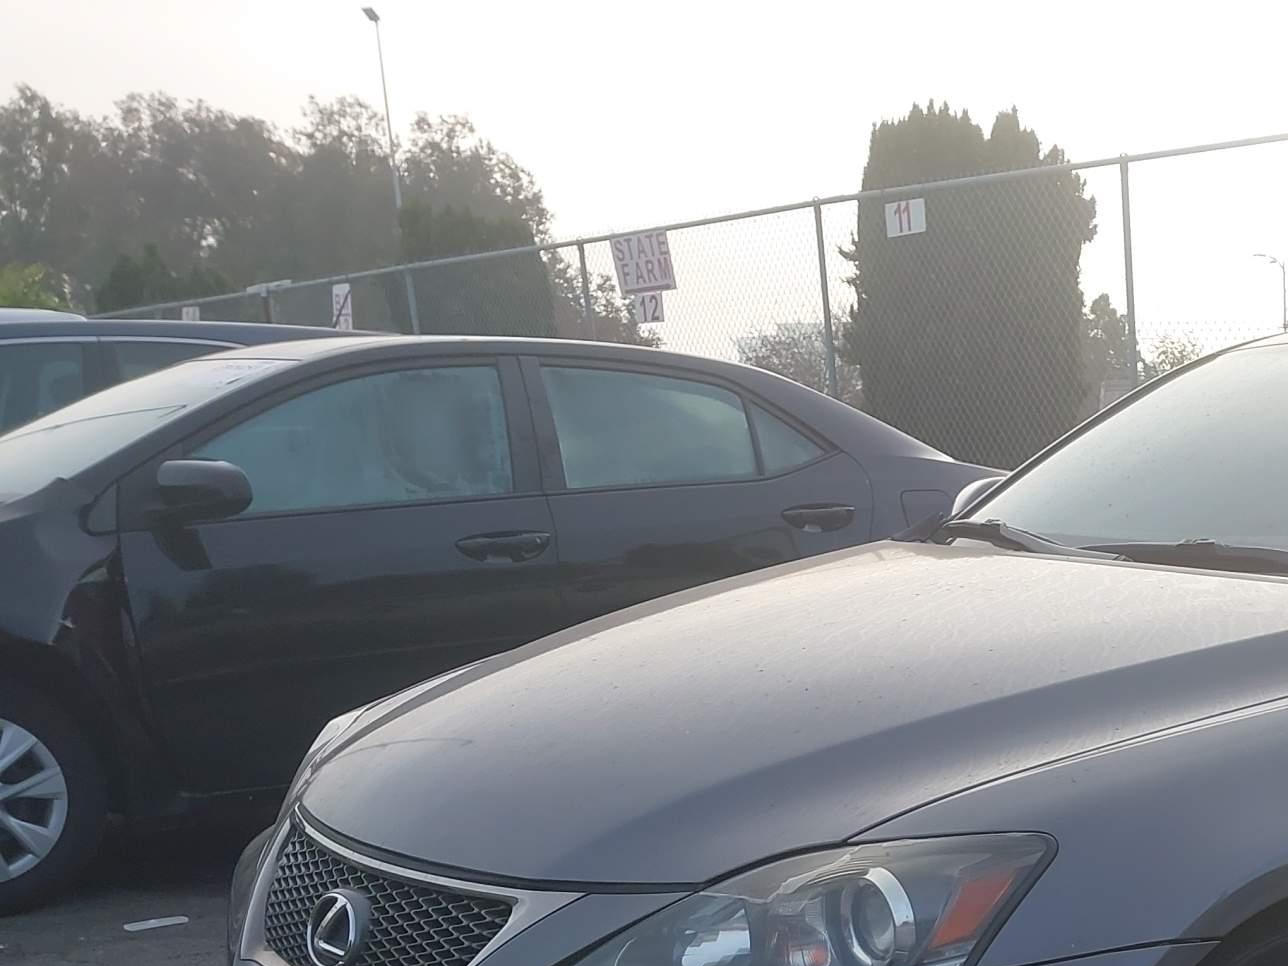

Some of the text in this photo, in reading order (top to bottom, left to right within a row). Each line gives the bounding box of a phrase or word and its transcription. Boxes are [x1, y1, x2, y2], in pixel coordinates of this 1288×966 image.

[894, 201, 911, 233] 11
[613, 232, 669, 262] STATE
[621, 257, 672, 286] FARM
[640, 295, 660, 322] 12
